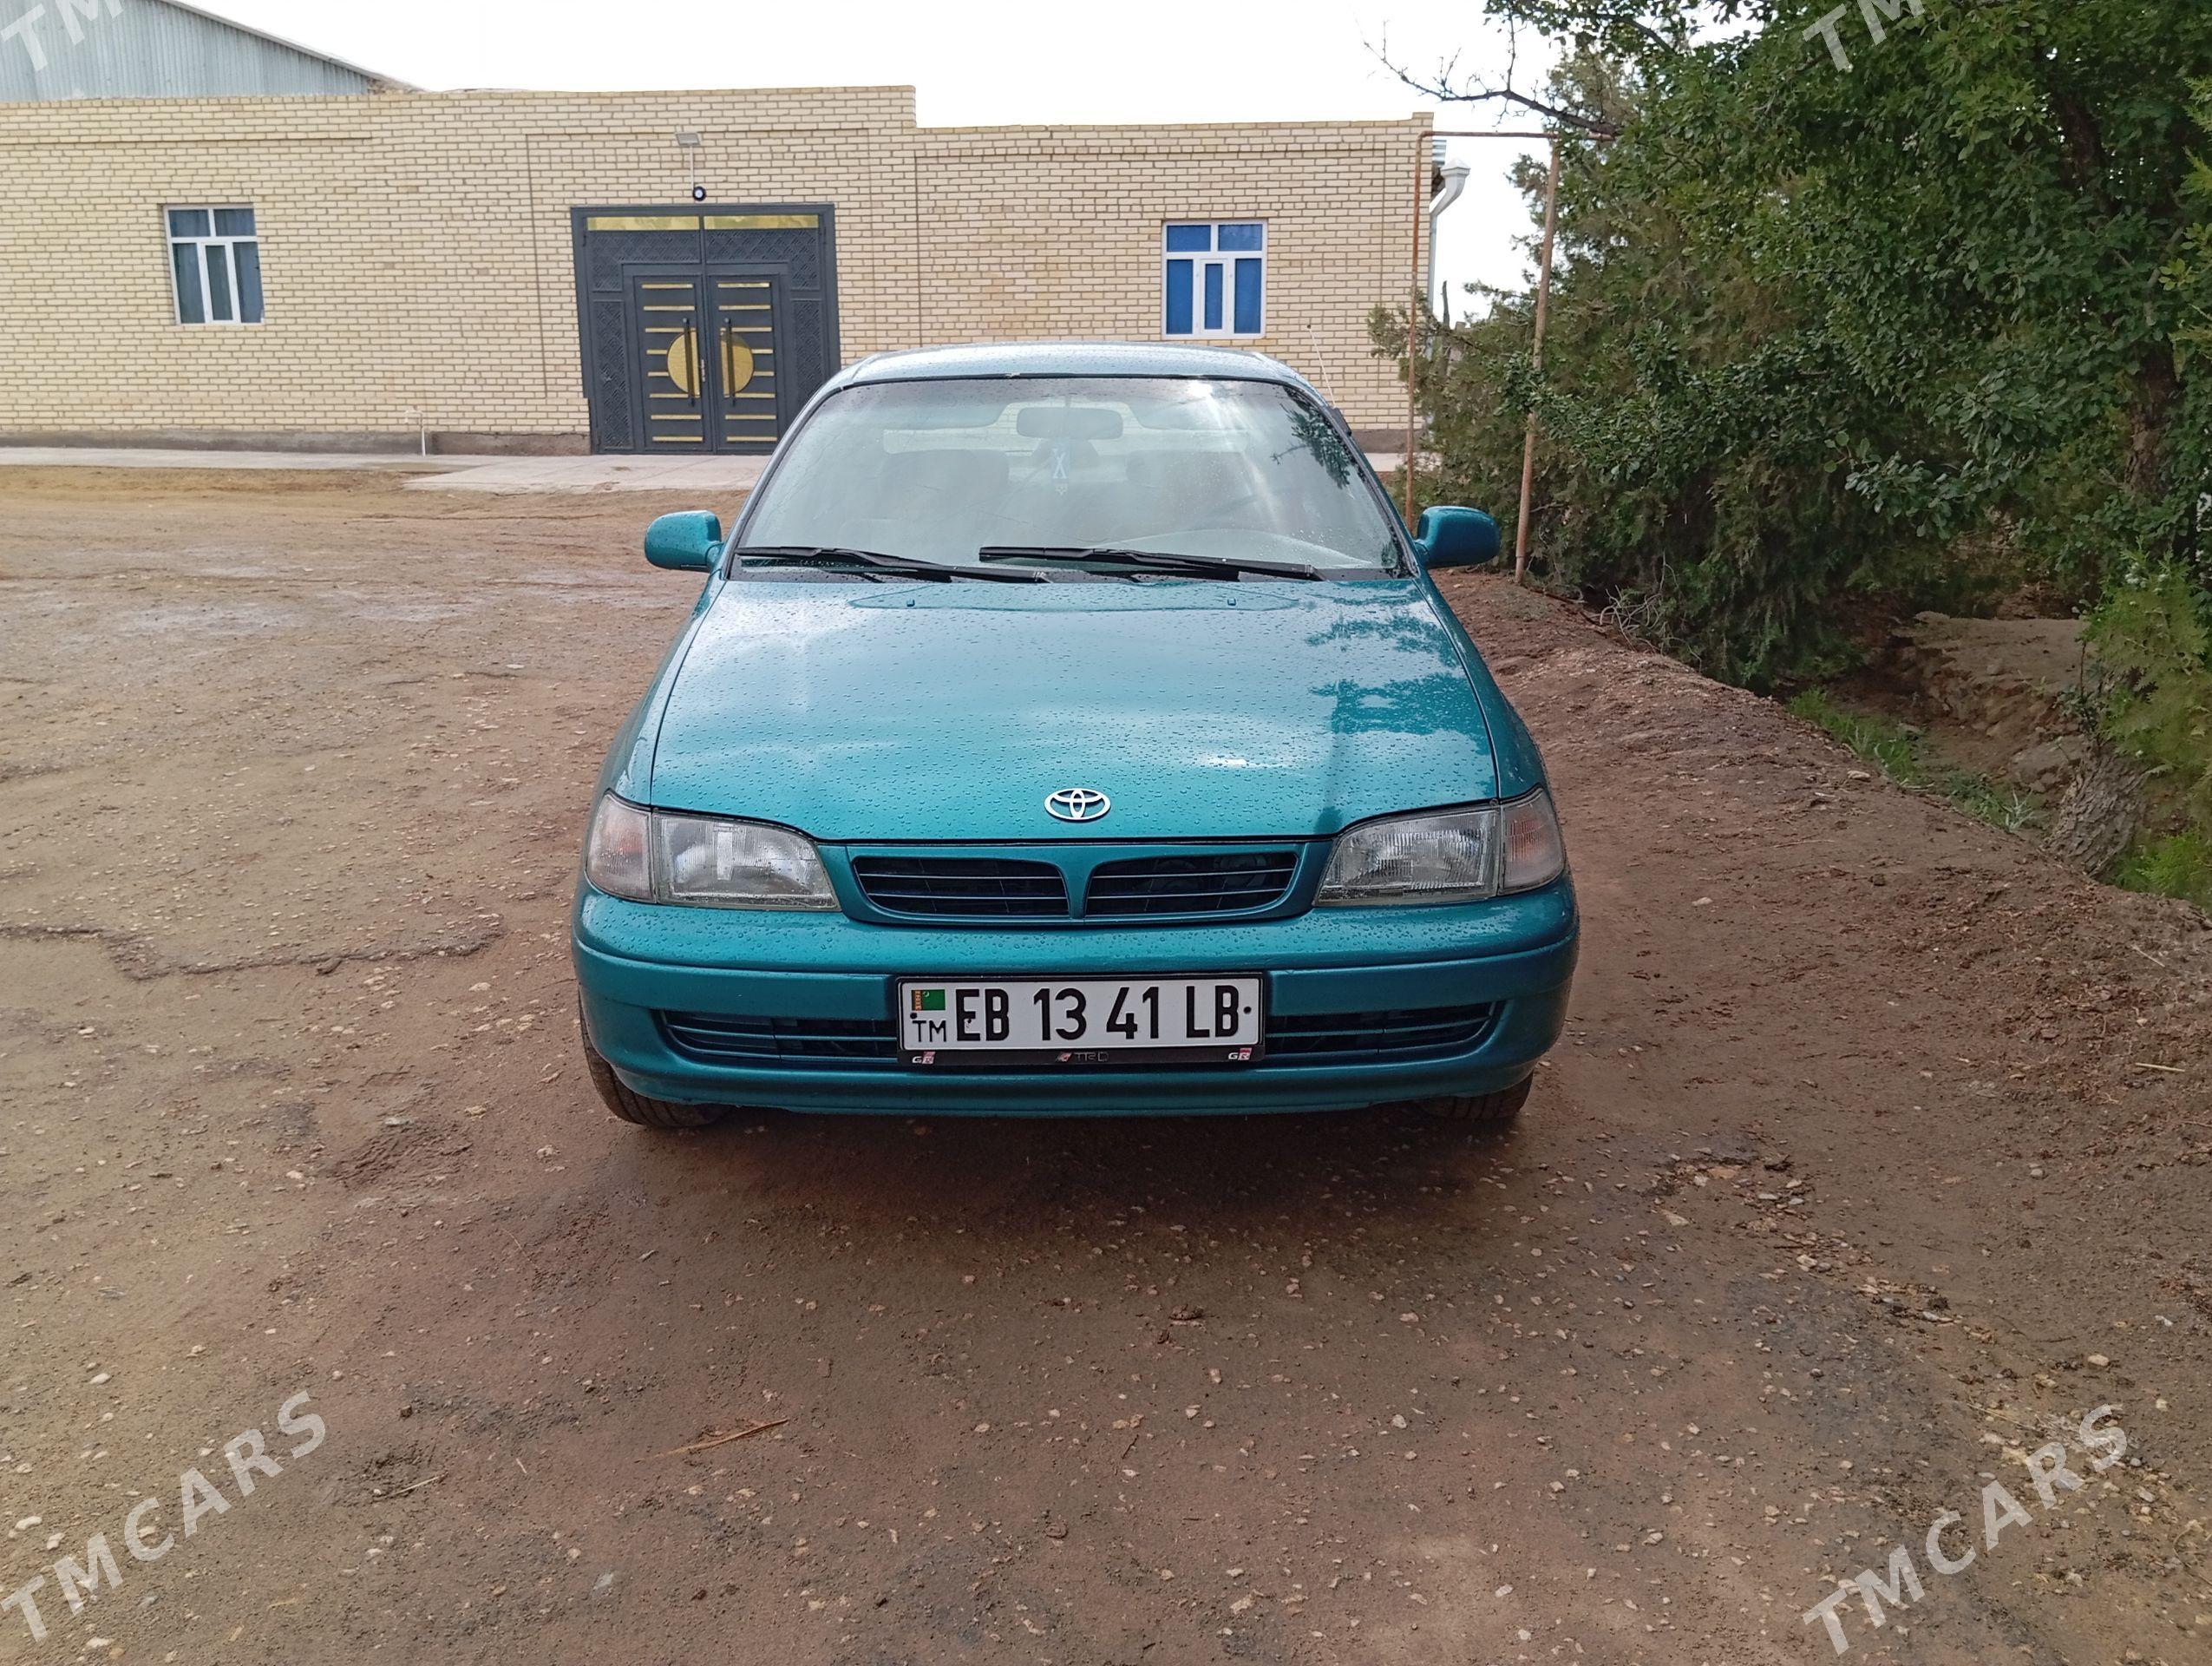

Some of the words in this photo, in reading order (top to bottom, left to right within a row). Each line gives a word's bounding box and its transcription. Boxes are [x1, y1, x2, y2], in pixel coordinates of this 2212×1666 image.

[956, 988, 1010, 1042] EB
[1033, 987, 1088, 1041] 13
[1106, 987, 1160, 1040] 41
[1186, 985, 1240, 1039] LB
[912, 1020, 947, 1043] TM
[1227, 1047, 1253, 1060] GR
